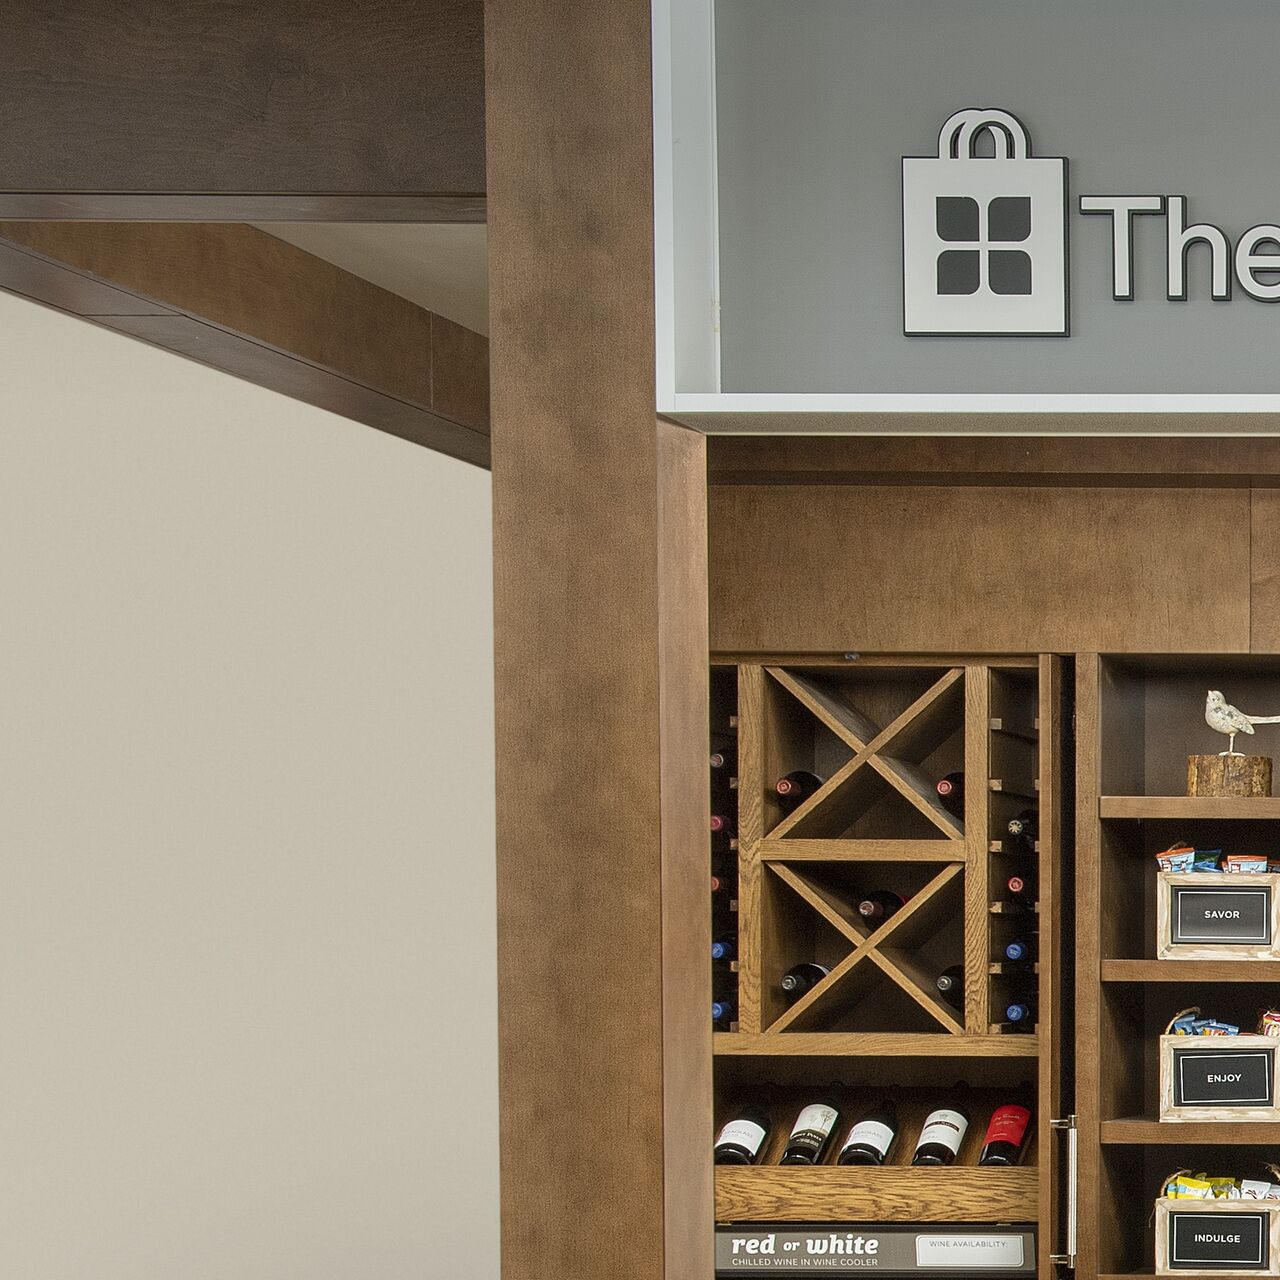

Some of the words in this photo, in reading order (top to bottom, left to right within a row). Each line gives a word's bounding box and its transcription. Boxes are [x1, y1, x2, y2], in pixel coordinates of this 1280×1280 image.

[1204, 910, 1240, 919] SAVOR
[1207, 1073, 1242, 1083] ENJOY
[1194, 1234, 1241, 1244] INDULGE
[732, 1234, 776, 1255] red
[783, 1239, 801, 1252] or
[806, 1233, 879, 1255] white
[929, 1240, 951, 1248] WINE
[732, 1258, 772, 1267] CHILLED
[773, 1258, 799, 1267] WINE
[801, 1258, 811, 1267] IN
[813, 1258, 838, 1267] WINE
[840, 1258, 879, 1267] COOLER
